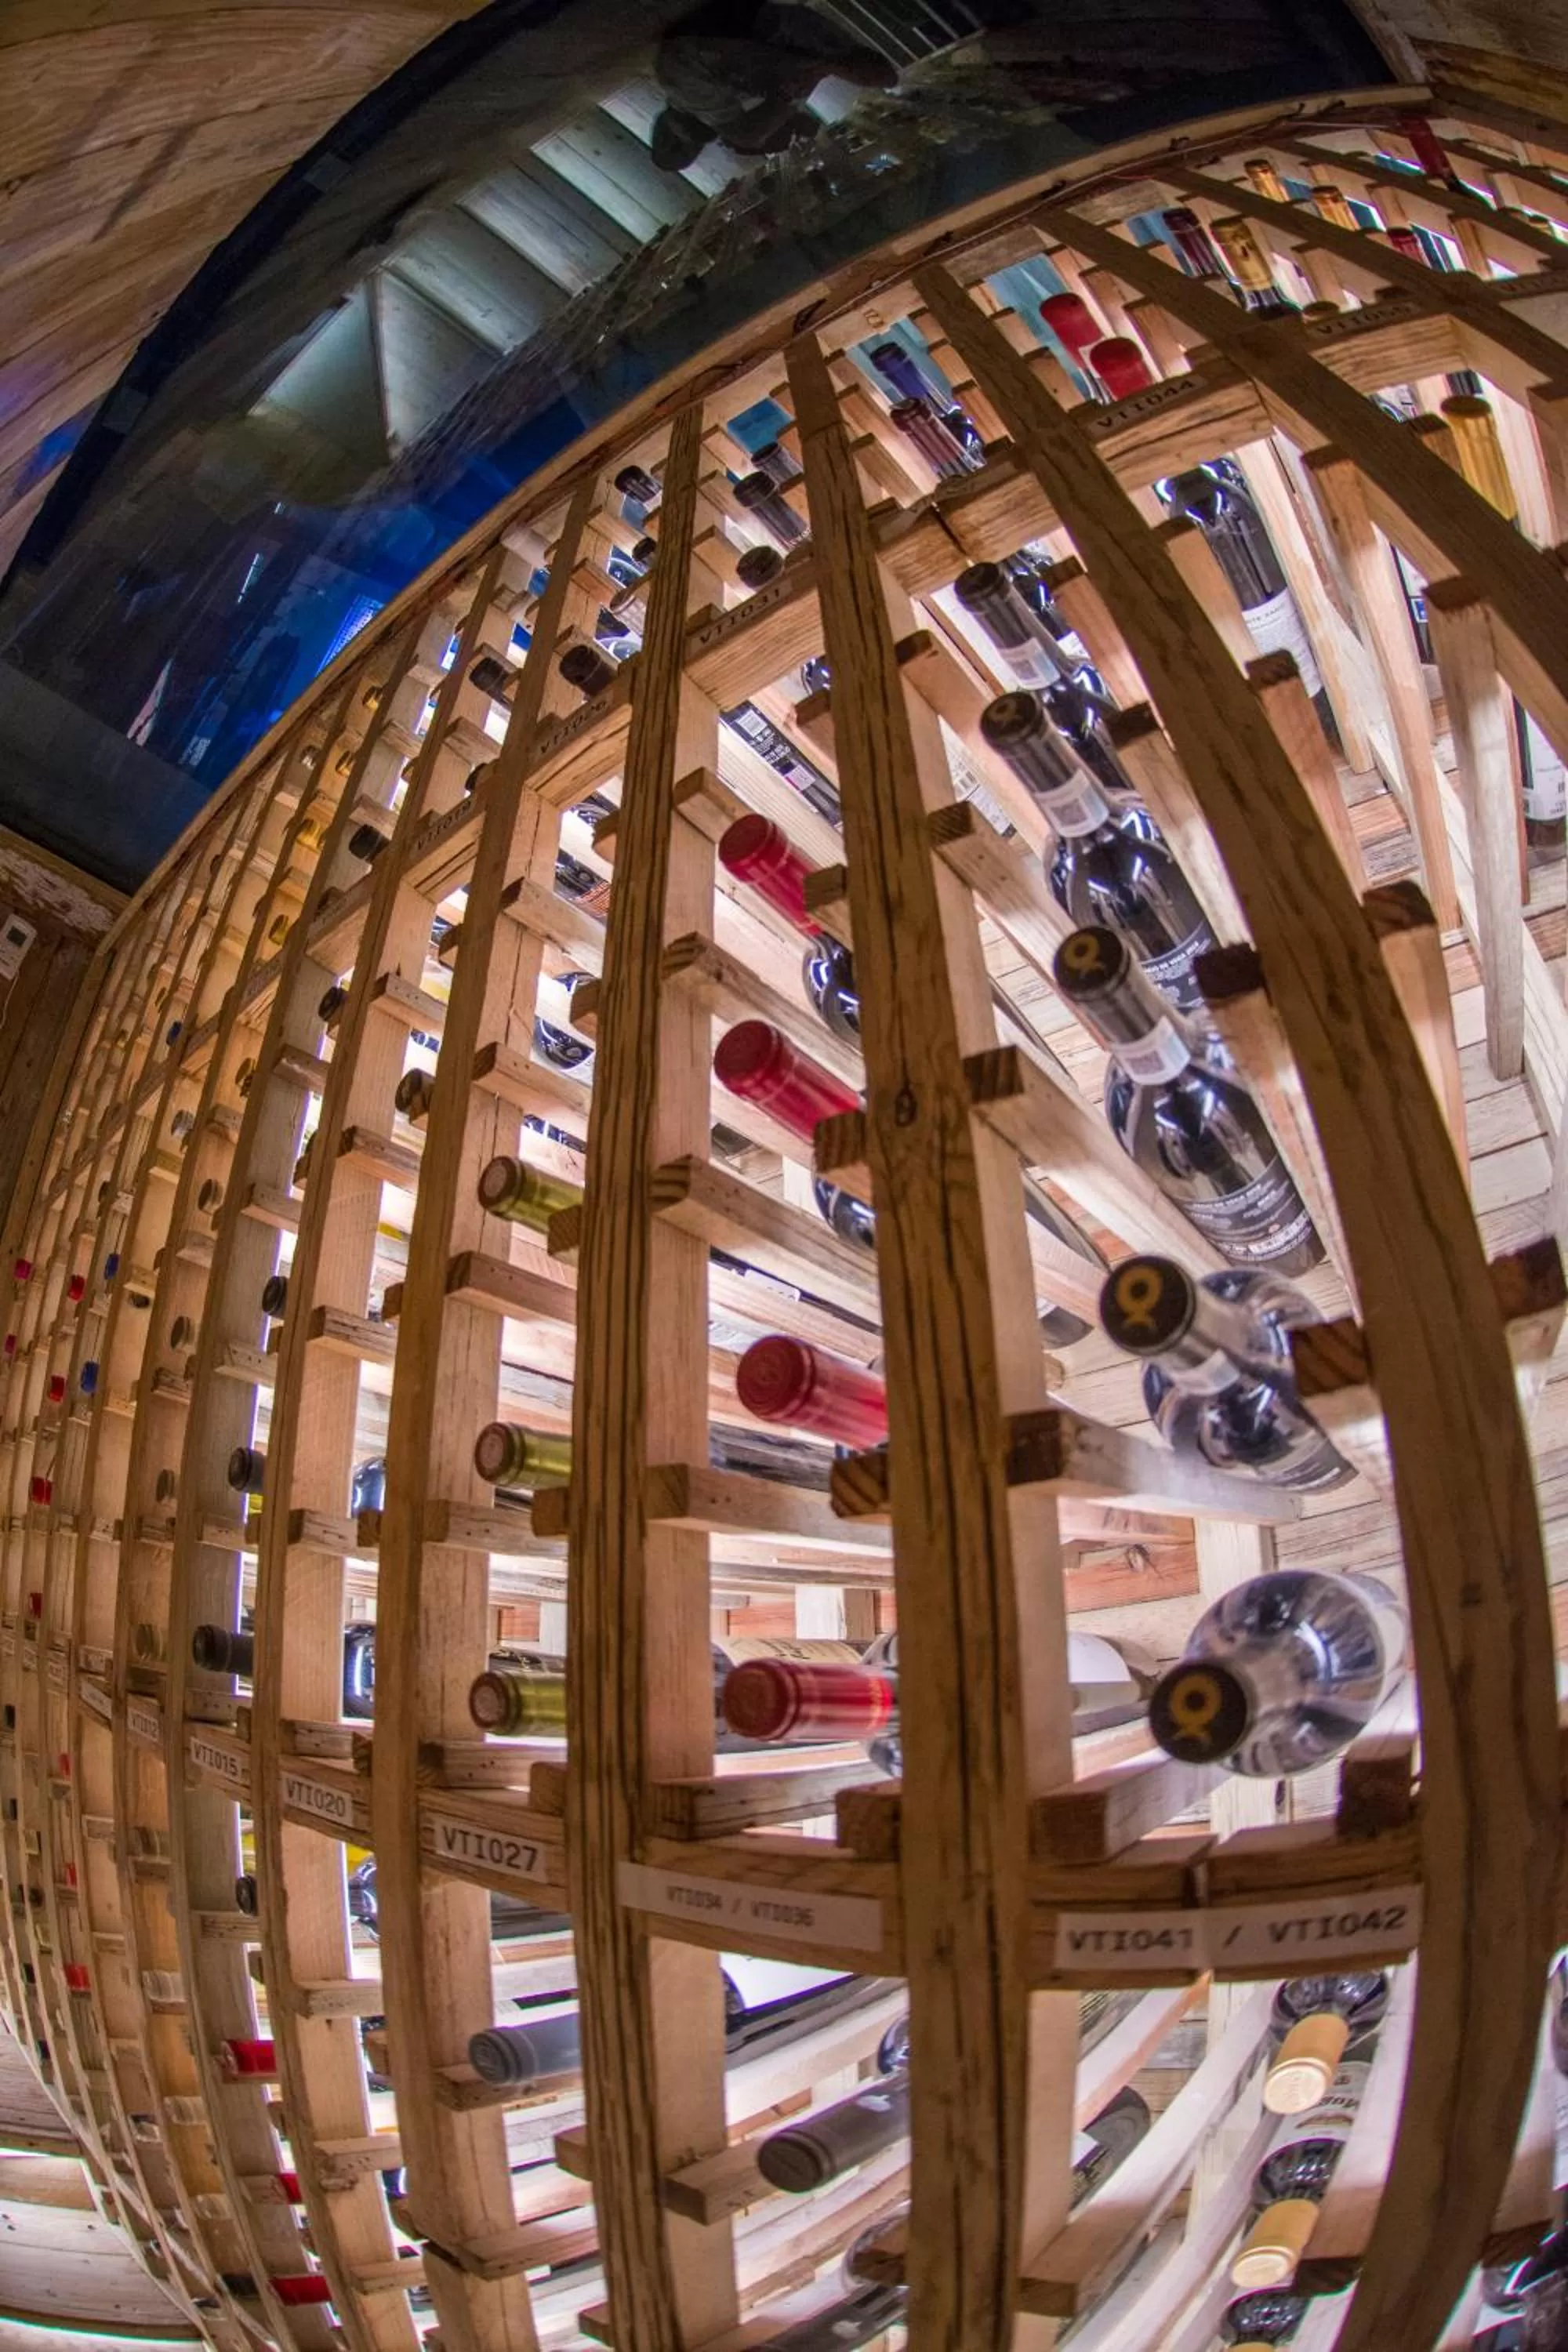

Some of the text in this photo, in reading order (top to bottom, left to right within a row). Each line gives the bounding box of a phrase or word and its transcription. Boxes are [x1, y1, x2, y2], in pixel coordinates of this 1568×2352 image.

[1098, 379, 1194, 428] VTI044
[193, 1742, 238, 1777] VTI015
[285, 1777, 346, 1817] VTI020
[441, 1825, 538, 1872] VTI027
[731, 1898, 742, 1914] /
[1068, 1903, 1409, 1952] VTI041 / VTI042
